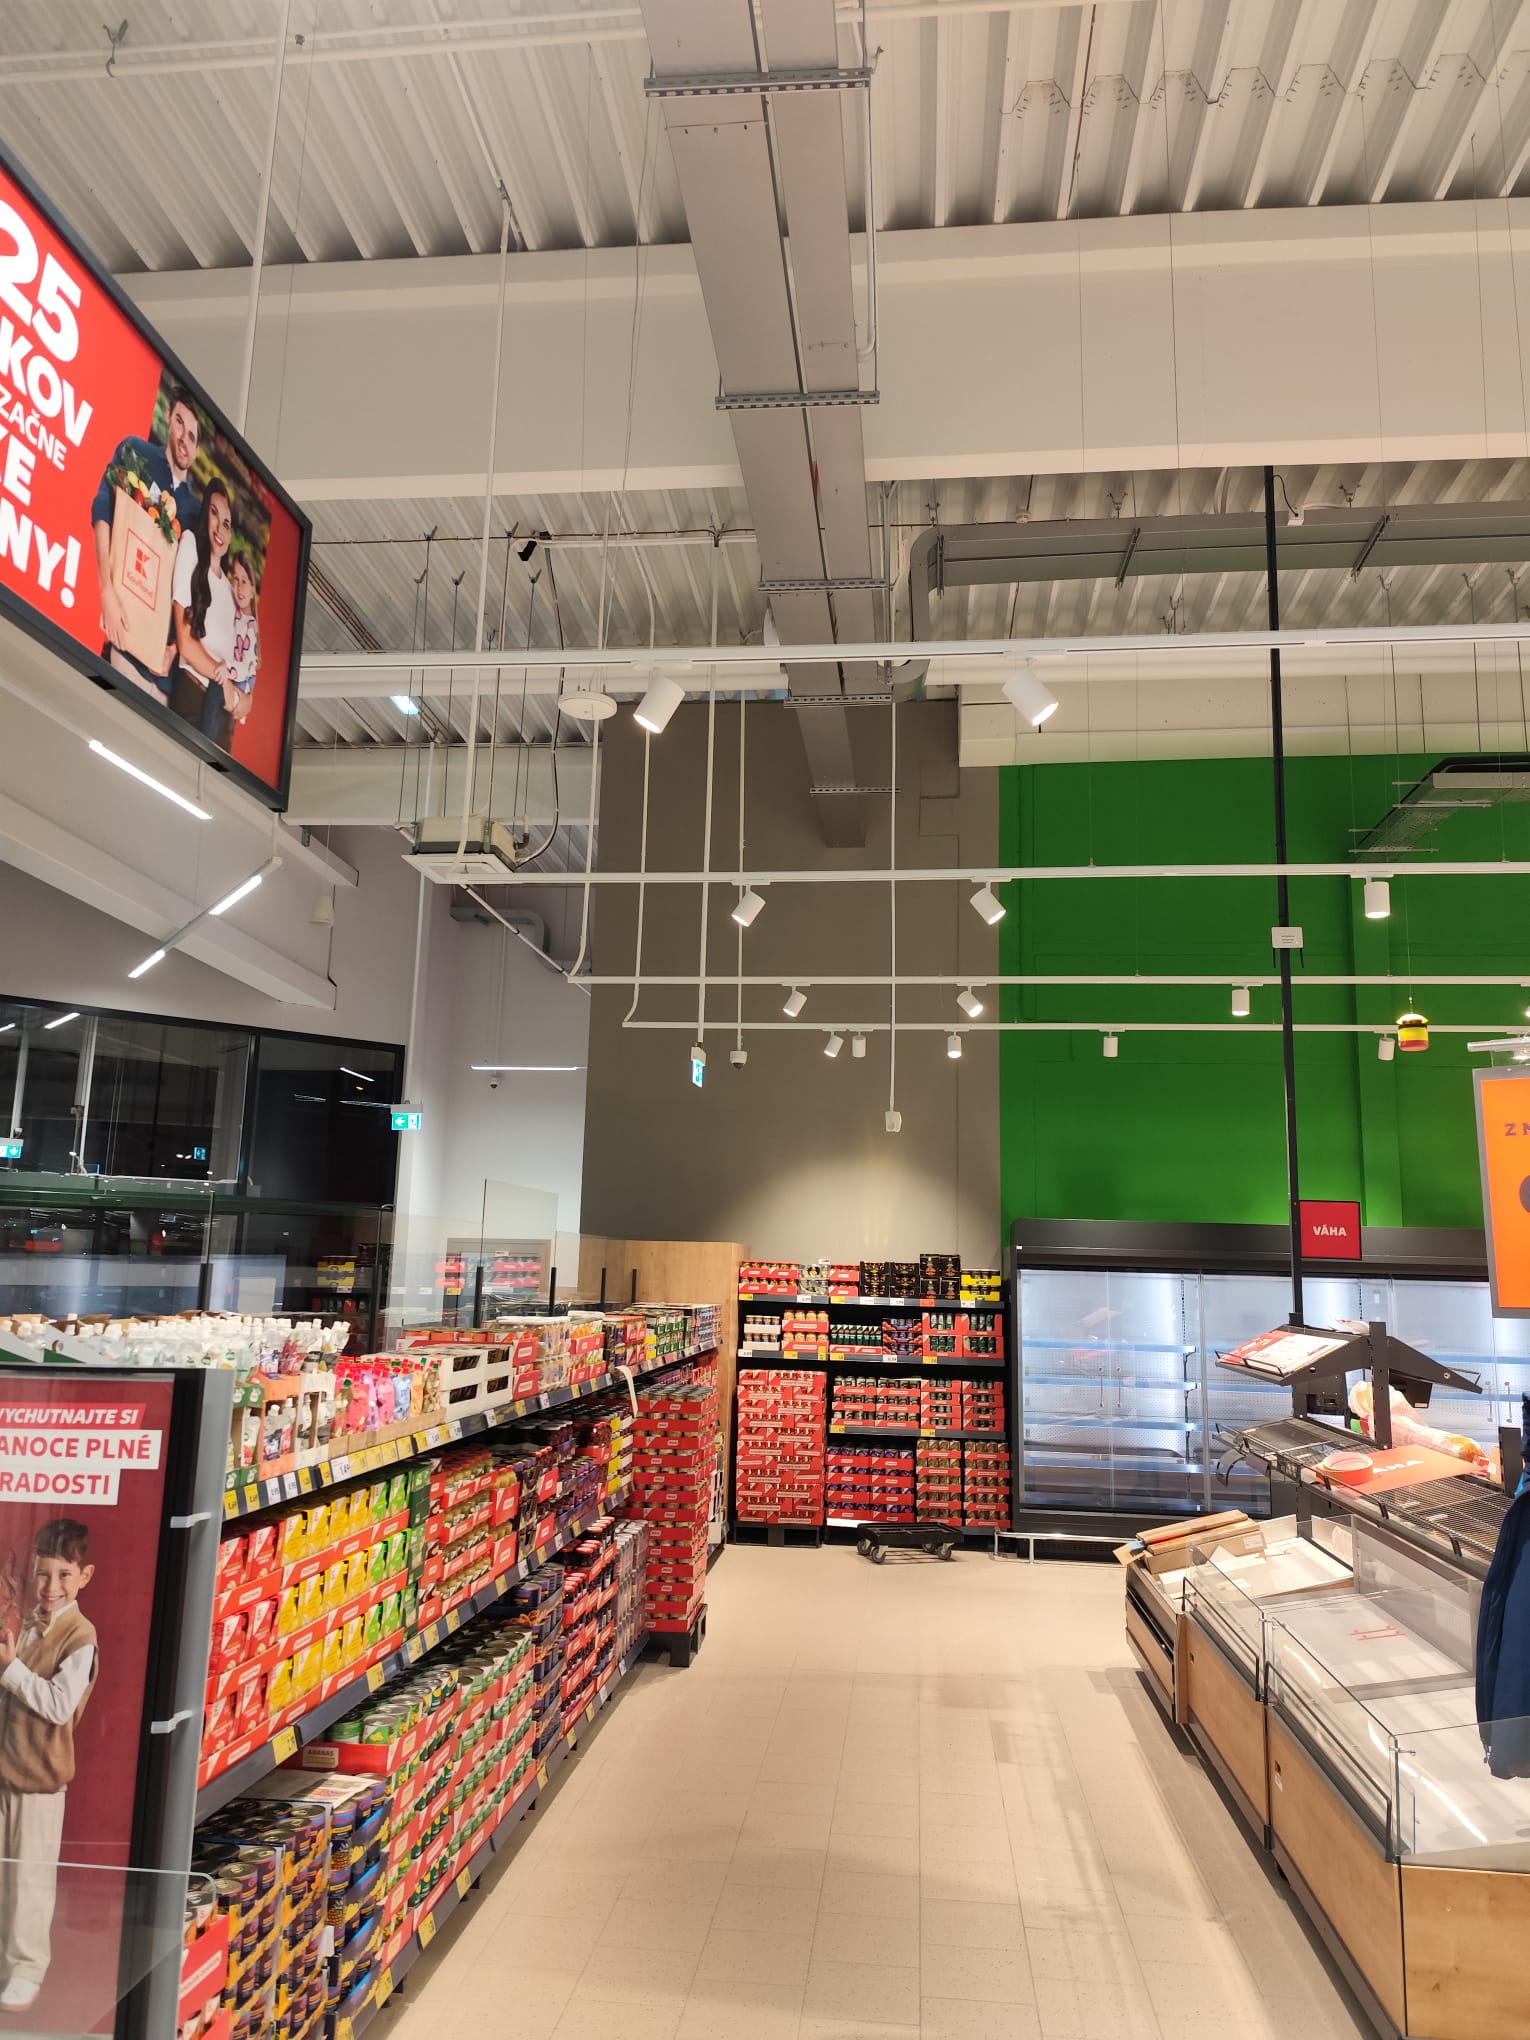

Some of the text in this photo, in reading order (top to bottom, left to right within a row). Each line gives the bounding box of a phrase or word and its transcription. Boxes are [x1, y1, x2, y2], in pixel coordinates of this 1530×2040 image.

[0, 316, 93, 447] KOV
[1312, 1224, 1347, 1237] VÁHA
[119, 1409, 139, 1425] SI
[85, 1434, 152, 1460] PLNÉ
[0, 1471, 110, 1495] RADOSTI
